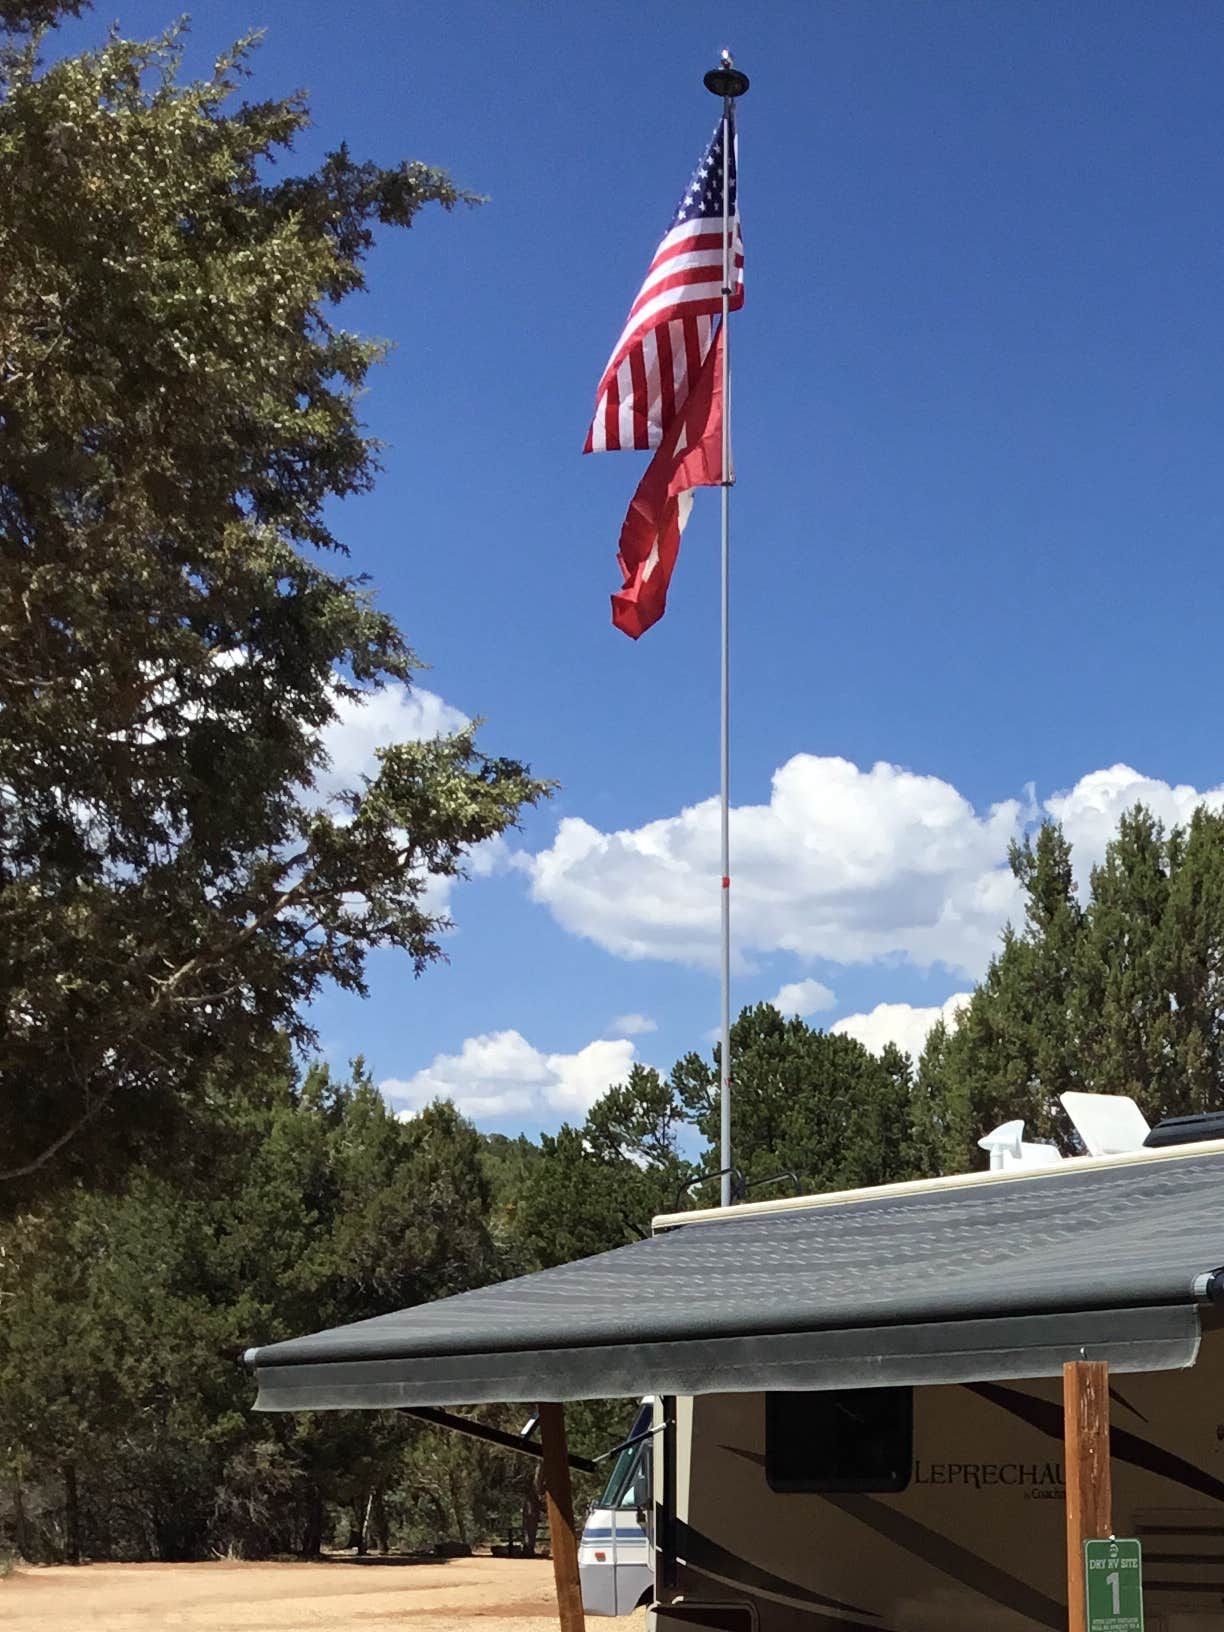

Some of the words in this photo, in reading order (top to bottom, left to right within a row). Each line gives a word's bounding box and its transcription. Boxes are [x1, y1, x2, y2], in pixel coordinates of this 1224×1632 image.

[915, 1461, 1066, 1489] LEPRECHAU
[1089, 1559, 1106, 1570] DRY
[1107, 1558, 1120, 1569] RV
[1120, 1558, 1138, 1569] SITE
[1106, 1572, 1120, 1615] 1
